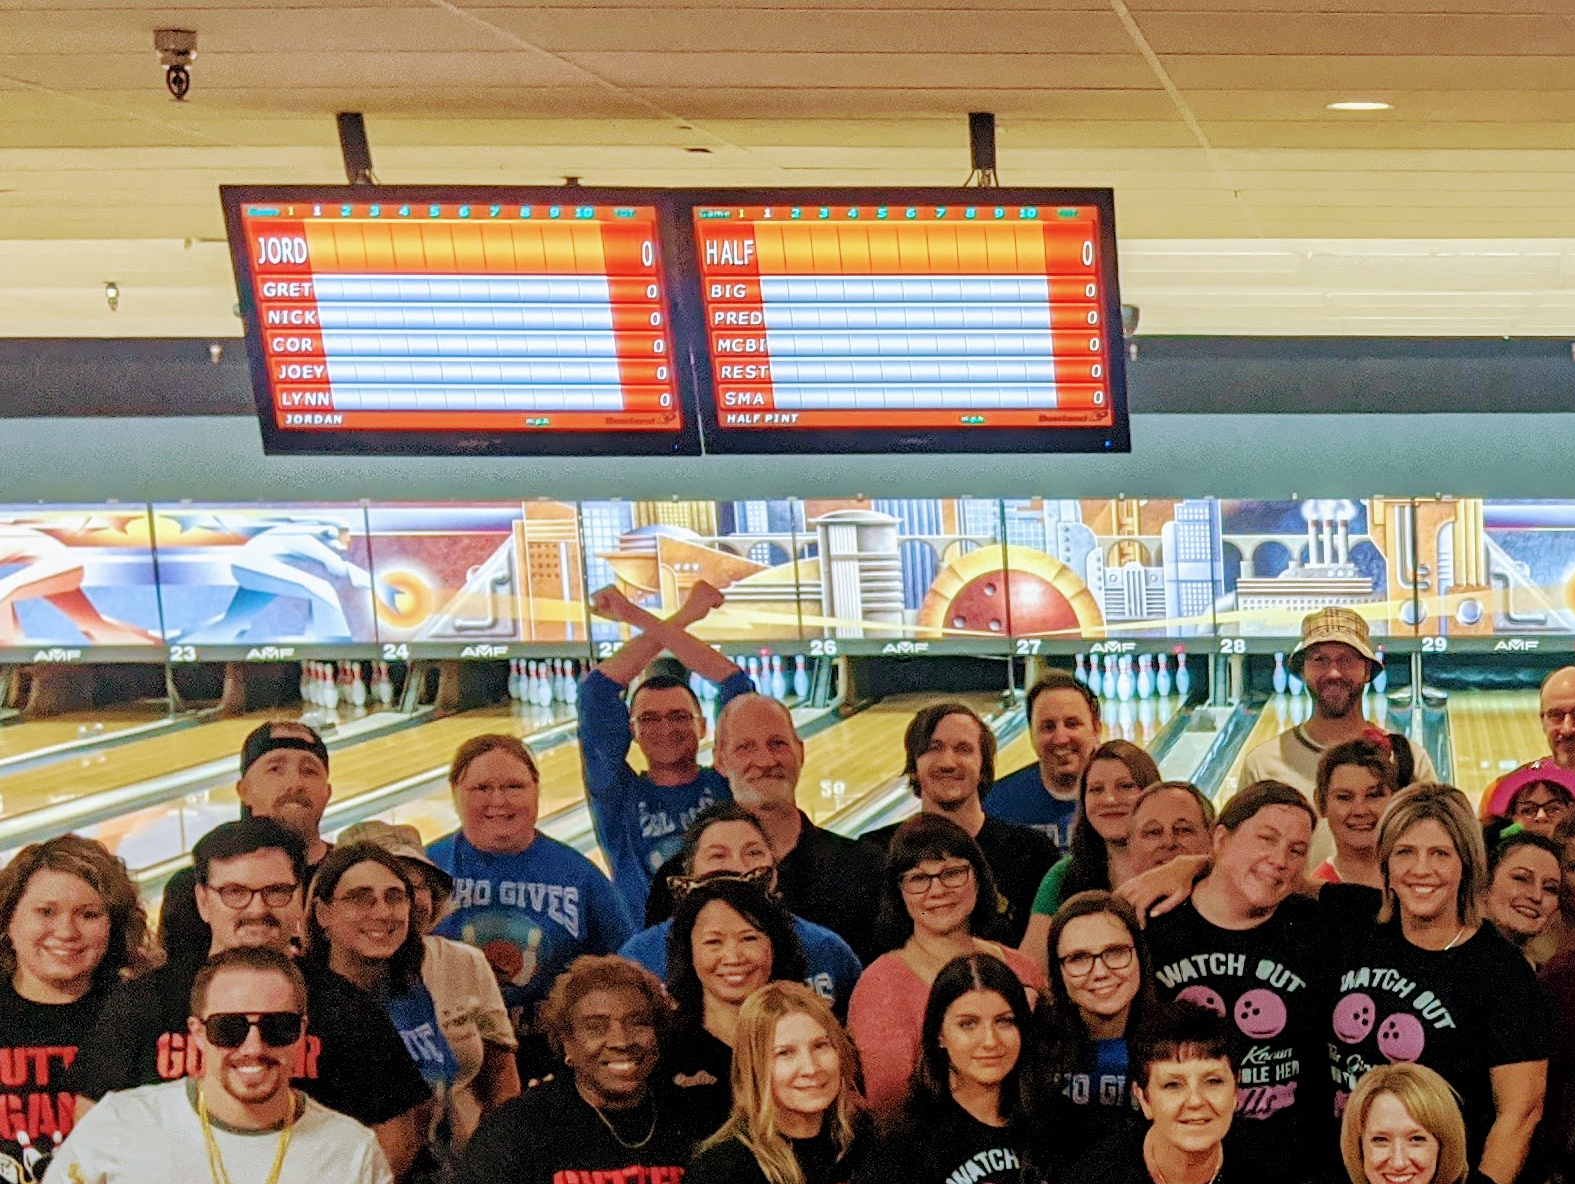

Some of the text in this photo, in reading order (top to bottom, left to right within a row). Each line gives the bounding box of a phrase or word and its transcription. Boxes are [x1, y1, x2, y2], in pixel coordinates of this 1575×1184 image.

[288, 206, 295, 216] 1
[313, 205, 594, 218] 1 2 3 4 5 6 7 8 9 10
[738, 208, 745, 218] 1
[763, 207, 1038, 219] 1 2 3 4 5 6 7 8 9 10
[258, 236, 308, 265] JORD
[642, 240, 653, 266] 0
[705, 240, 754, 266] HALF
[1082, 240, 1093, 266] 0
[263, 282, 312, 297] GRET
[647, 285, 658, 298] 0
[711, 284, 746, 298] BIG
[1085, 284, 1096, 297] 0
[268, 310, 316, 324] NICK
[650, 312, 661, 326] 0
[714, 311, 762, 325] PRED
[1087, 311, 1098, 324] 0
[272, 337, 312, 352] COR
[653, 339, 664, 353] 0
[717, 338, 766, 352] MCBI
[1089, 337, 1100, 351] 0
[278, 365, 325, 379] JOEY
[656, 366, 667, 380] 0
[721, 365, 769, 379] REST
[1091, 364, 1102, 378] 0
[281, 392, 330, 406] LYNN
[659, 393, 671, 406] 0
[724, 392, 765, 405] SMA
[1093, 390, 1104, 404] 0
[285, 414, 343, 425] JORDAN
[727, 413, 799, 424] HALF PINT
[460, 645, 509, 658] AMF
[810, 640, 837, 656] 26
[882, 641, 930, 654] AMF
[1016, 639, 1042, 655] 27
[1089, 640, 1138, 653] AMF
[1220, 639, 1246, 654] 28
[1422, 637, 1448, 652] 29
[1493, 639, 1539, 651] AMF
[33, 647, 82, 661] AMF
[170, 646, 197, 662] 23
[246, 647, 295, 660] AMF
[382, 644, 410, 660] 24
[500, 880, 580, 938] GIVES
[1155, 952, 1306, 992] WATCH OUT
[1340, 967, 1457, 1029] WATCH OUT
